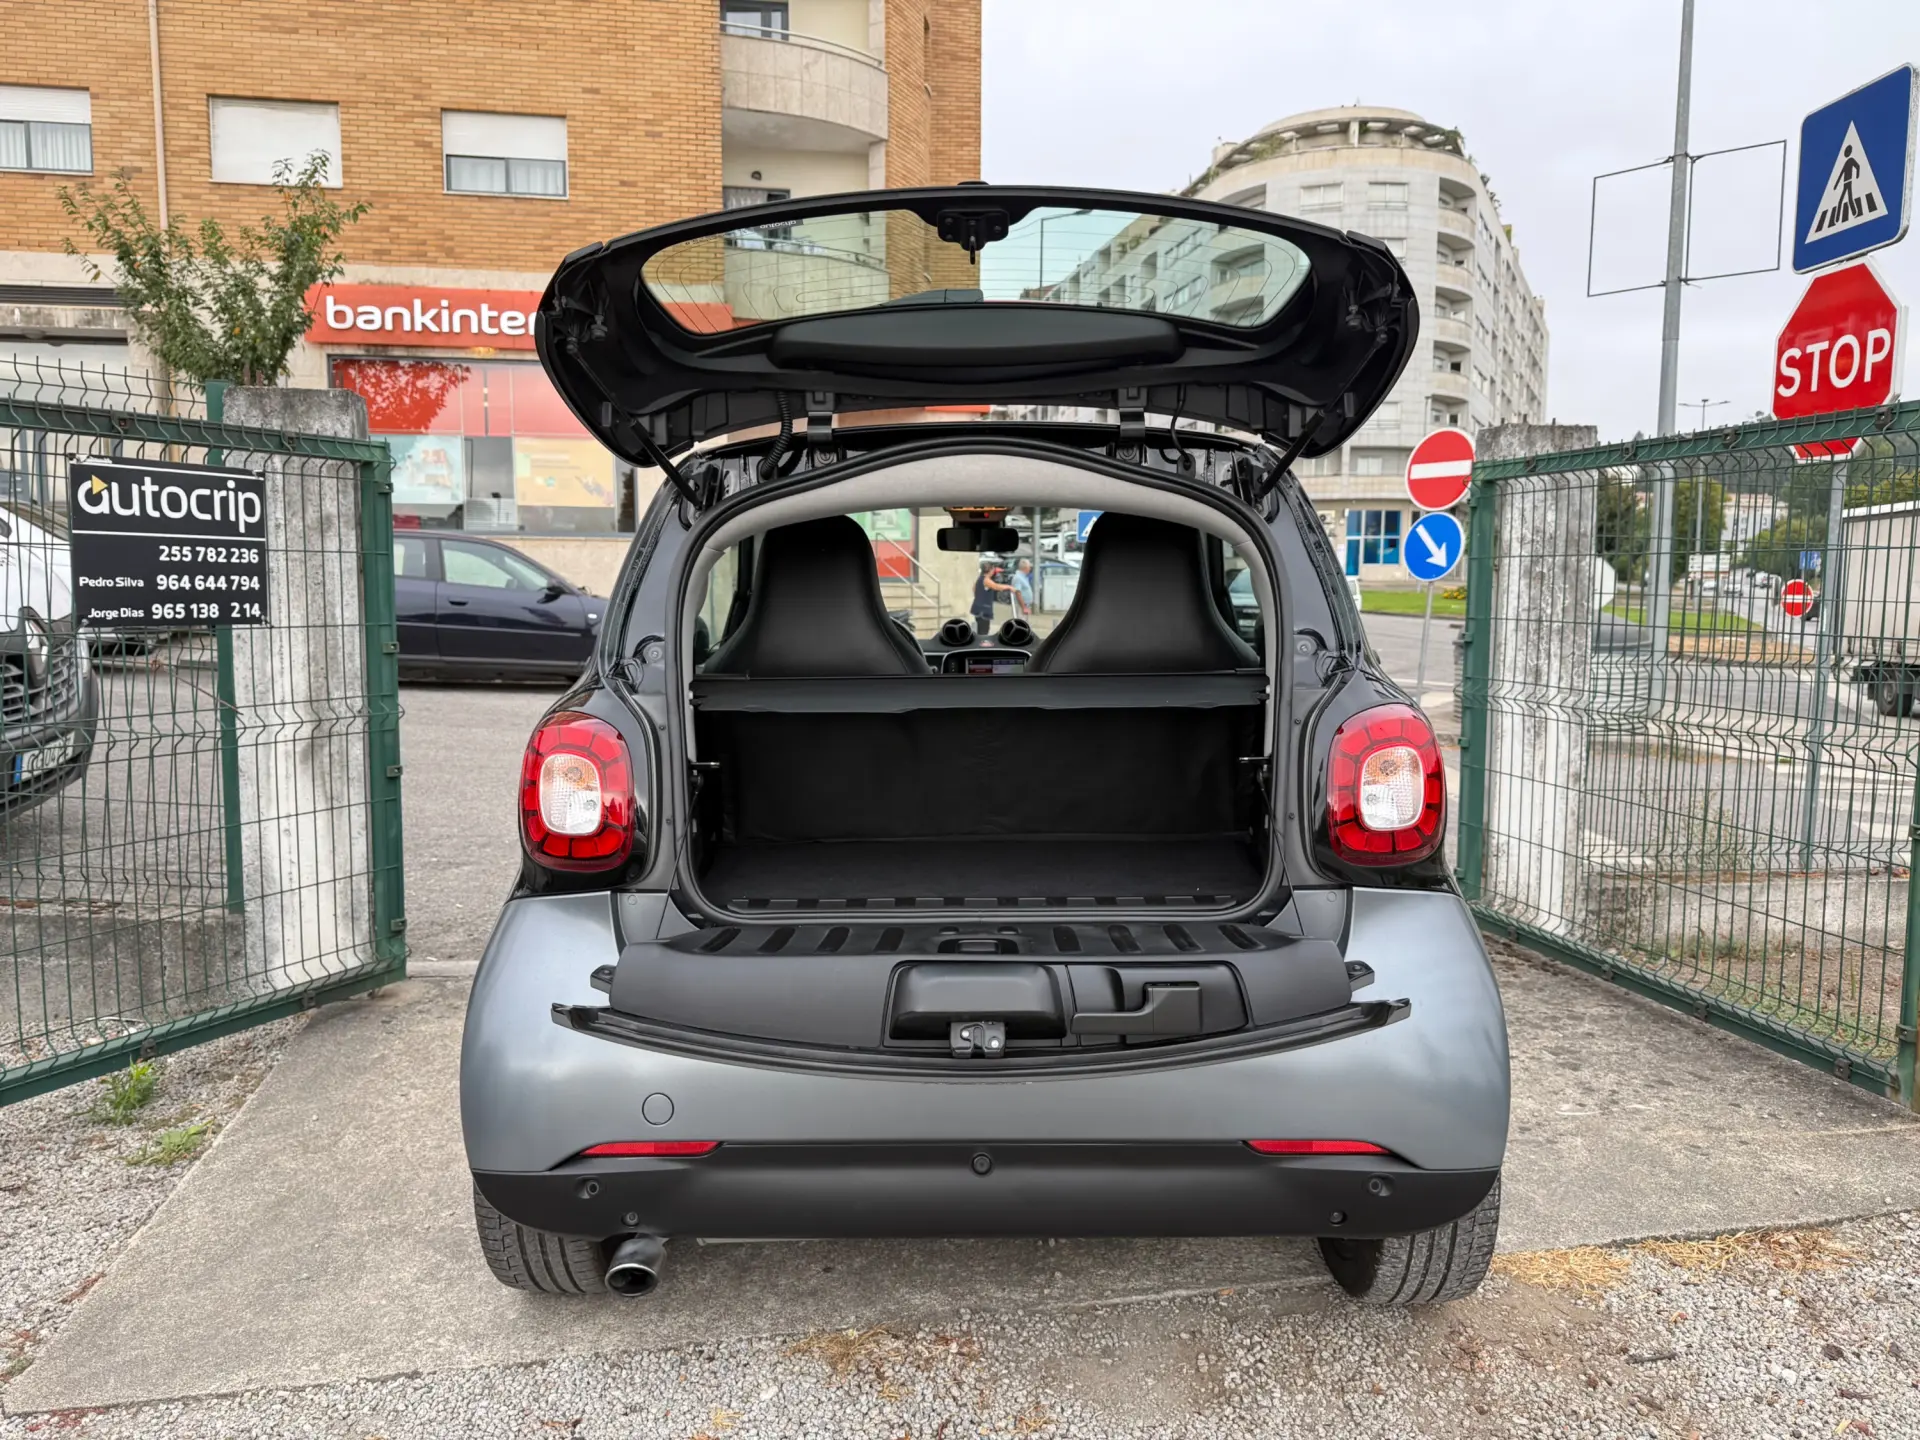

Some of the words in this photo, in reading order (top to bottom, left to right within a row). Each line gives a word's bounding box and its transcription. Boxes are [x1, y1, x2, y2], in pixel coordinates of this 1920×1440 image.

[1777, 328, 1892, 397] STOP
[77, 475, 261, 533] autocrip
[159, 545, 192, 562] 255
[195, 546, 227, 563] 782
[230, 548, 259, 564] 236
[79, 576, 114, 588] Pedro
[115, 577, 144, 588] Silva
[156, 574, 191, 591] 964
[194, 575, 227, 591] 644
[230, 575, 260, 591] 794
[88, 608, 119, 620] Jorge
[120, 608, 145, 619] Dias
[151, 603, 186, 620] 965
[190, 604, 219, 619] 138
